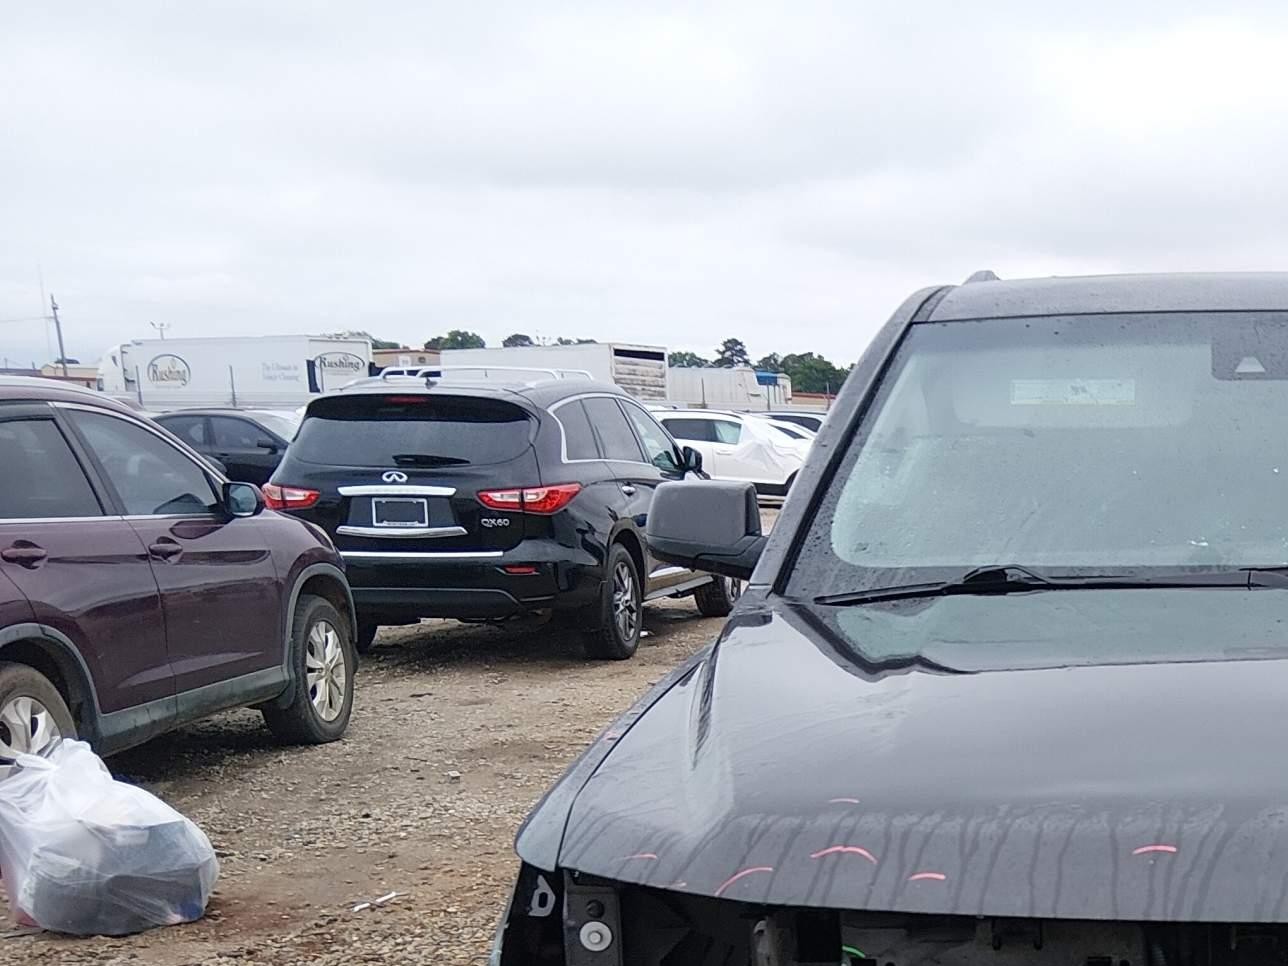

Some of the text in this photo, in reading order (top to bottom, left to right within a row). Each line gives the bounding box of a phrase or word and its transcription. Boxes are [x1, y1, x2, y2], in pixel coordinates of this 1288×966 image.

[318, 355, 361, 372] Rushing
[152, 363, 188, 386] Rushing
[480, 518, 510, 528] QX60
